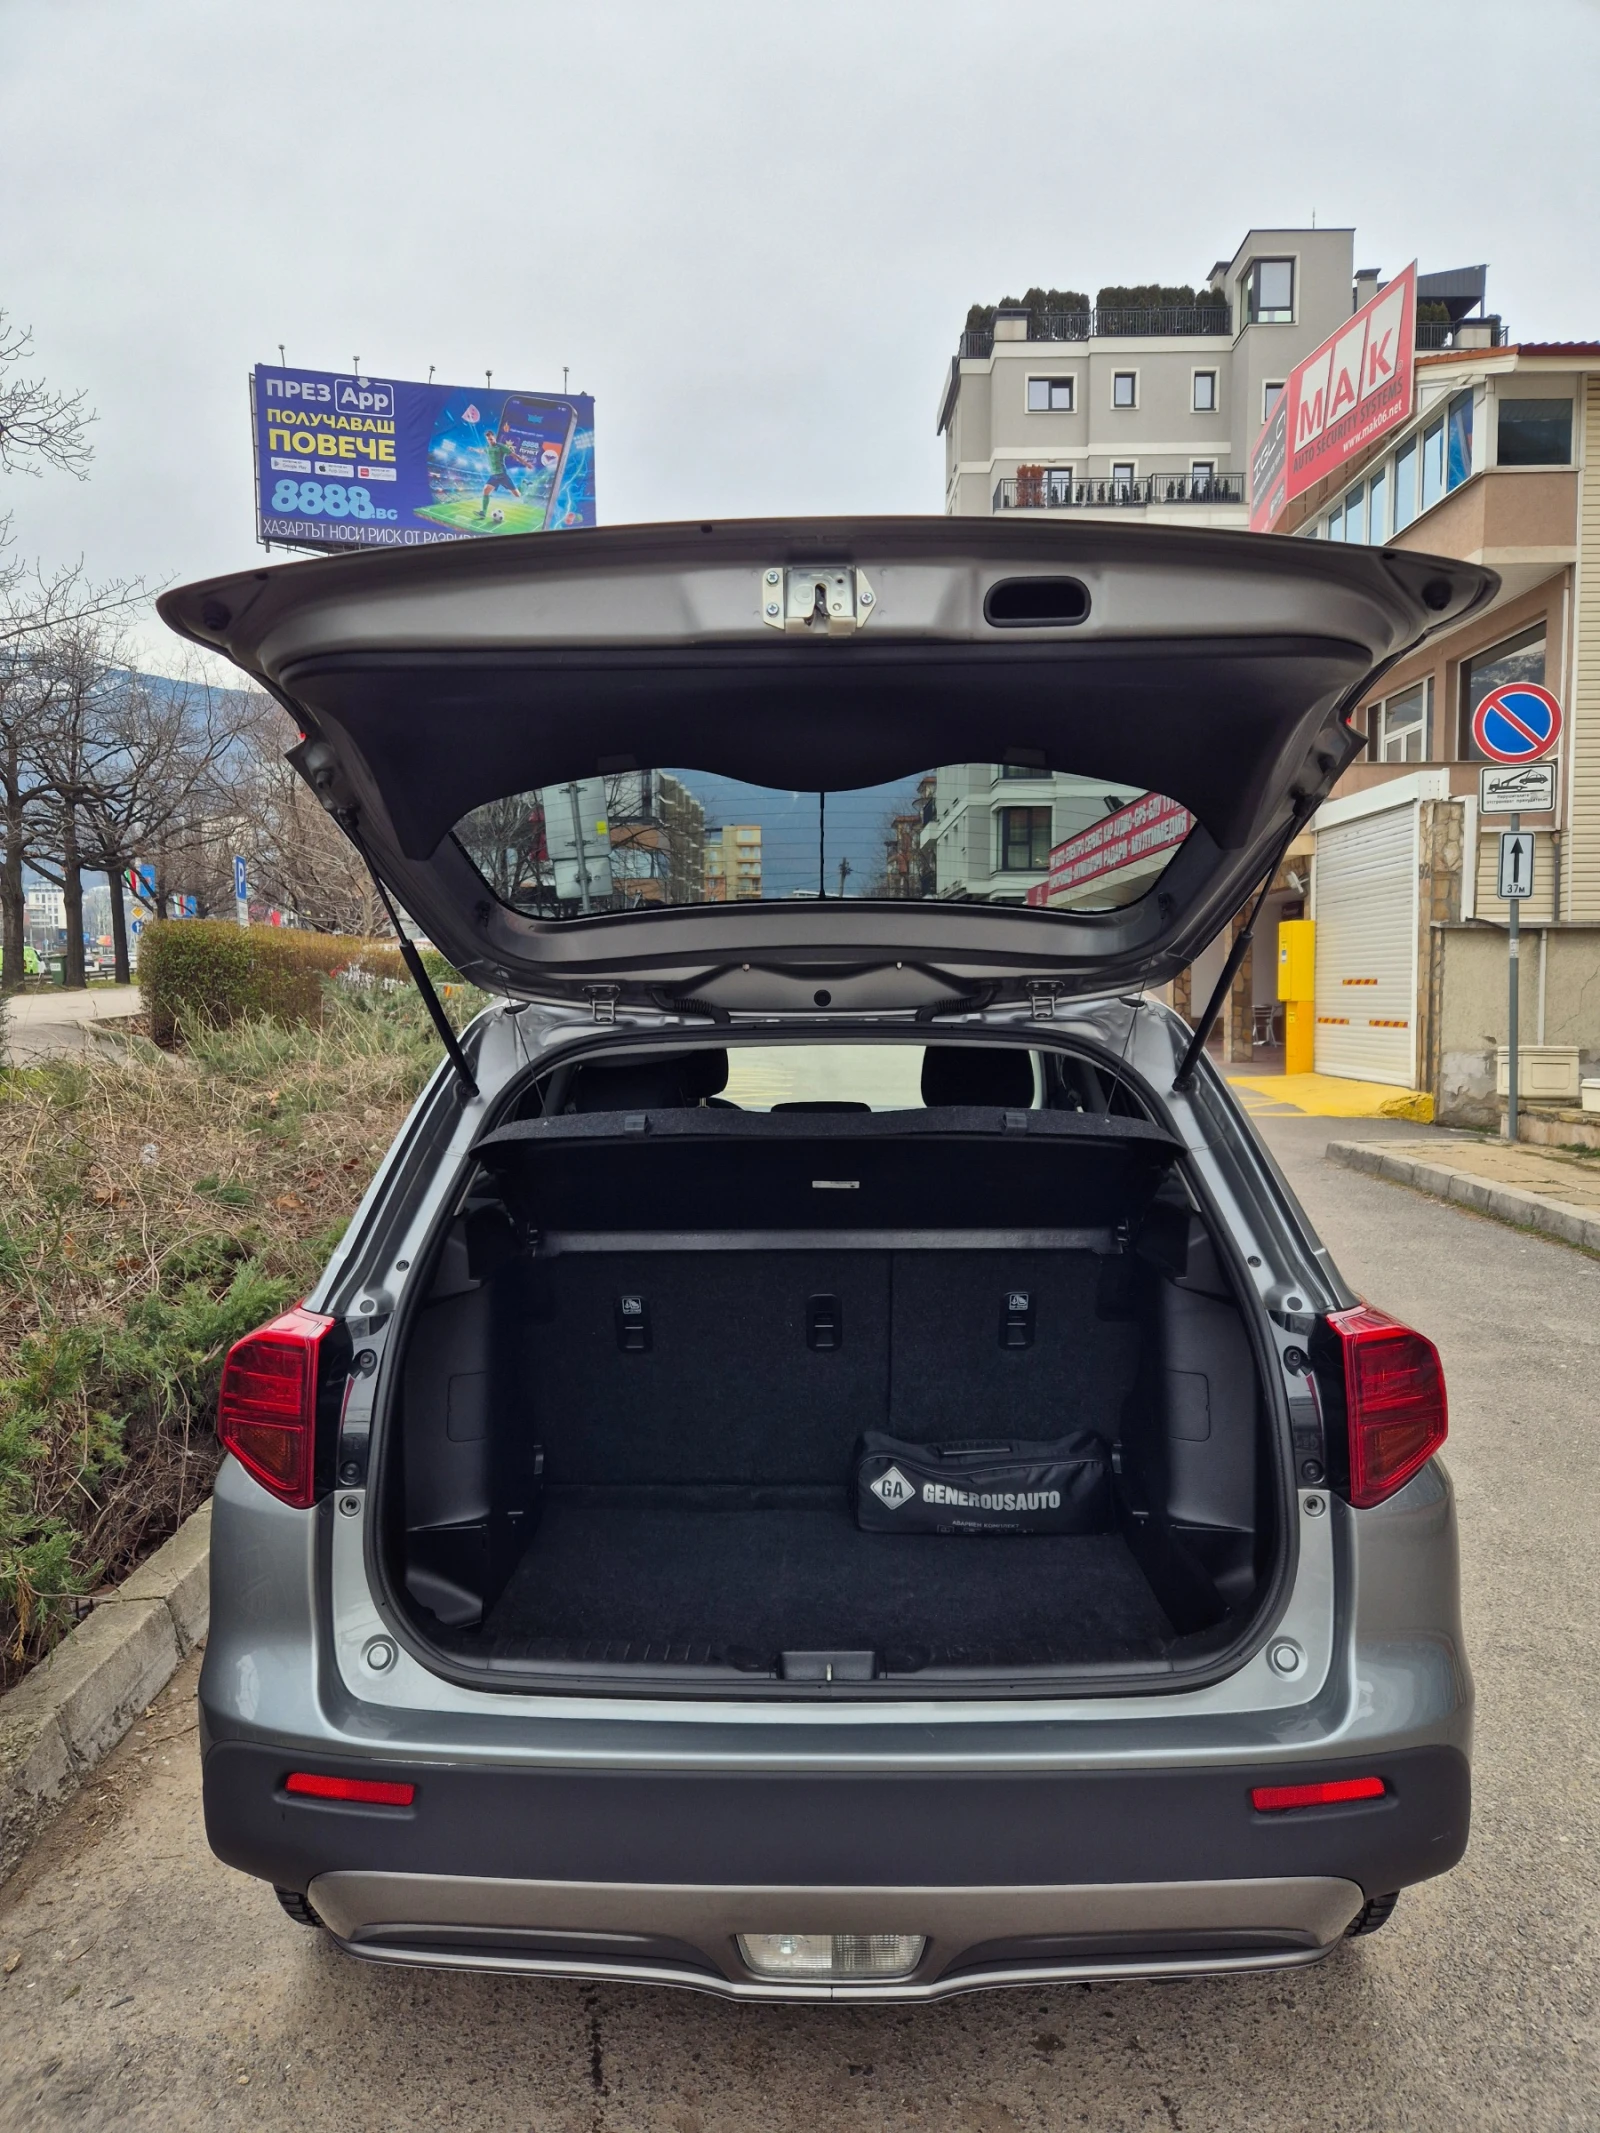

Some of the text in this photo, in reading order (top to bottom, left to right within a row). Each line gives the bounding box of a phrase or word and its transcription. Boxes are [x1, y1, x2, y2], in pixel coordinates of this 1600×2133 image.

[266, 379, 389, 411] ПРЕЗ App
[1299, 327, 1394, 444] MAK
[267, 408, 395, 434] ПОЛУЧАВАШ
[1293, 376, 1403, 474] AUTO SECURITY SYSTEMS
[1343, 398, 1403, 453] www.mak06.net
[269, 428, 396, 462] ПОВЕЧЕ
[263, 518, 326, 539] ХАЗАРТЪТ
[329, 525, 365, 541] НОСИ
[368, 528, 402, 544] РИСК
[405, 531, 420, 544] ОТ
[238, 861, 245, 893] P
[881, 1479, 904, 1500] GA
[922, 1483, 1061, 1512] GENEROUSAUTO
[952, 1520, 982, 1528] АВАРИЕН
